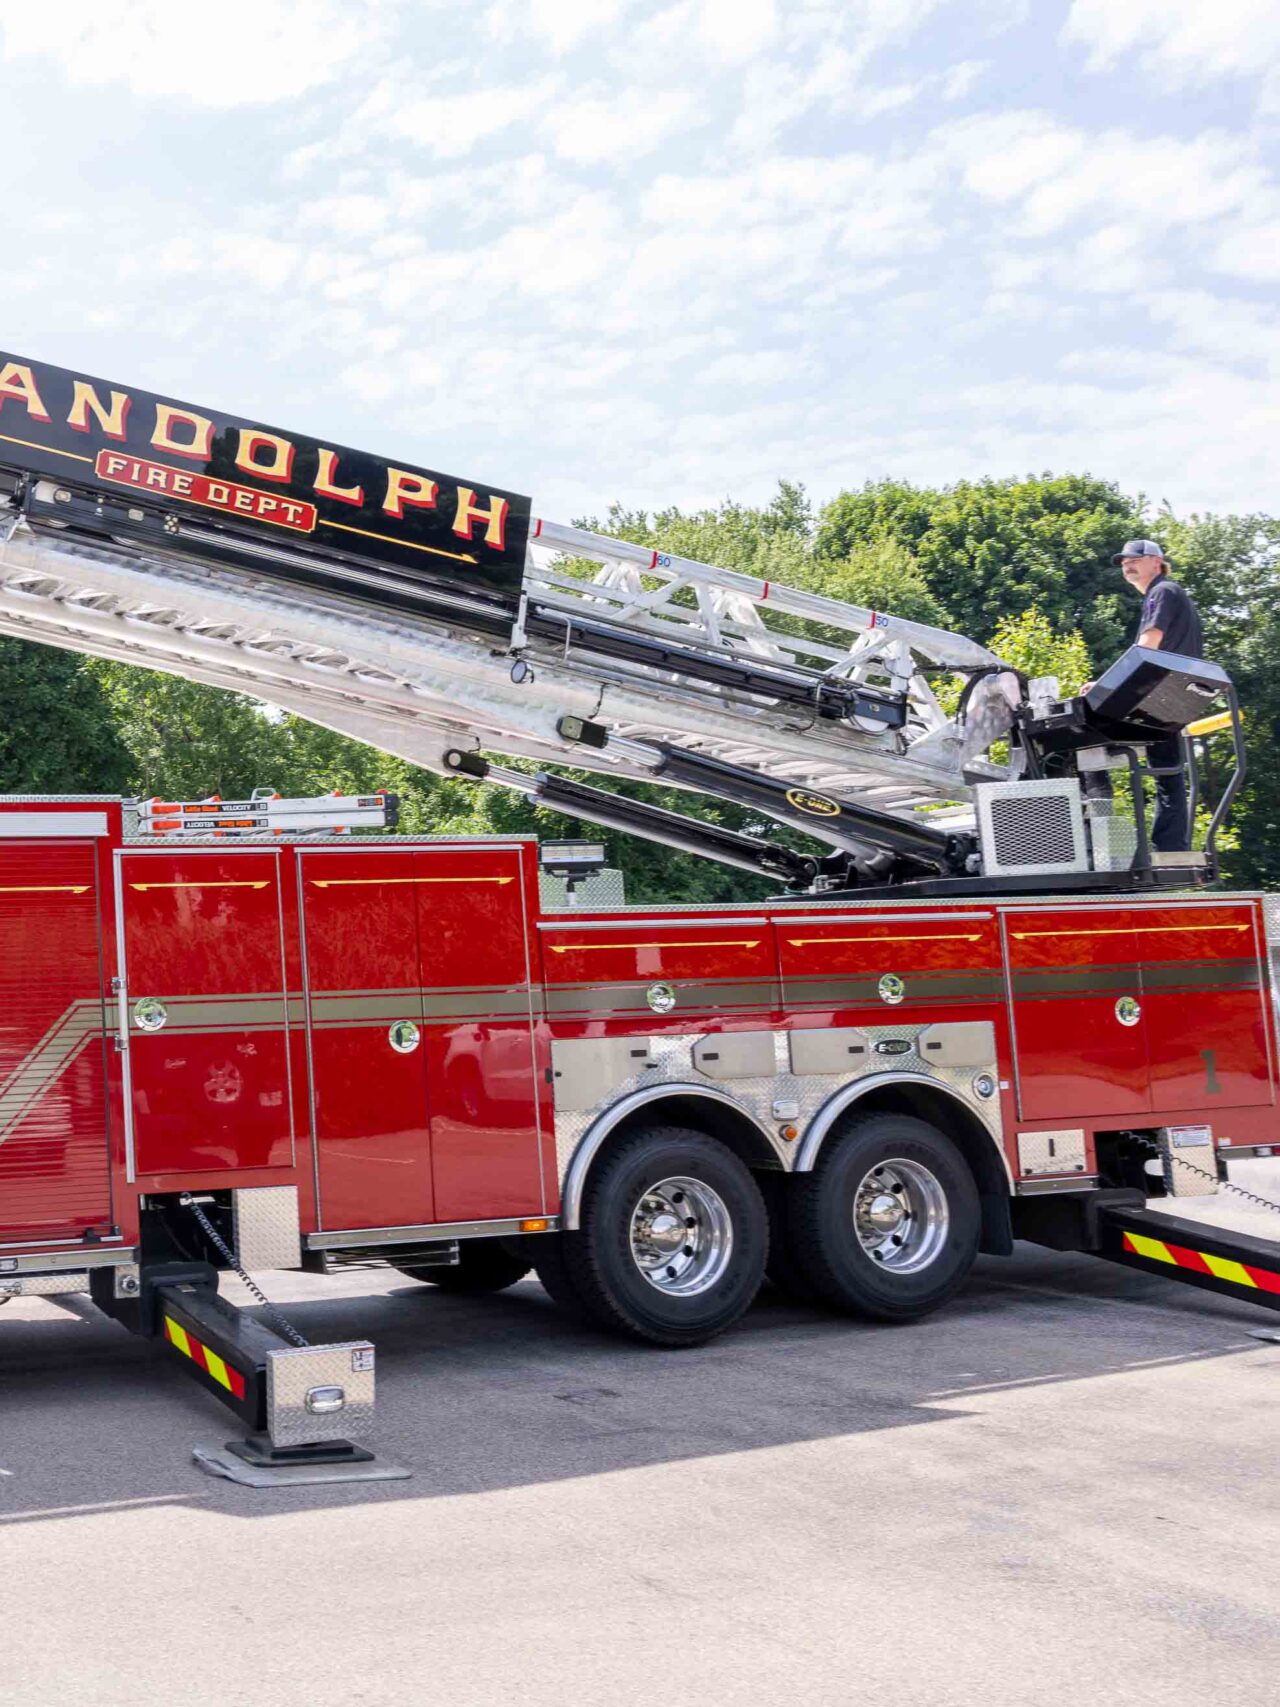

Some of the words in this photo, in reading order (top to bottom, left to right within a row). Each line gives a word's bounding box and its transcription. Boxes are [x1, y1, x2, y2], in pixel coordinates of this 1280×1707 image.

[106, 456, 194, 495] FIRE
[207, 482, 304, 524] DEPT.
[657, 555, 671, 568] 60
[875, 615, 889, 627] 50
[1200, 1048, 1223, 1095] 1
